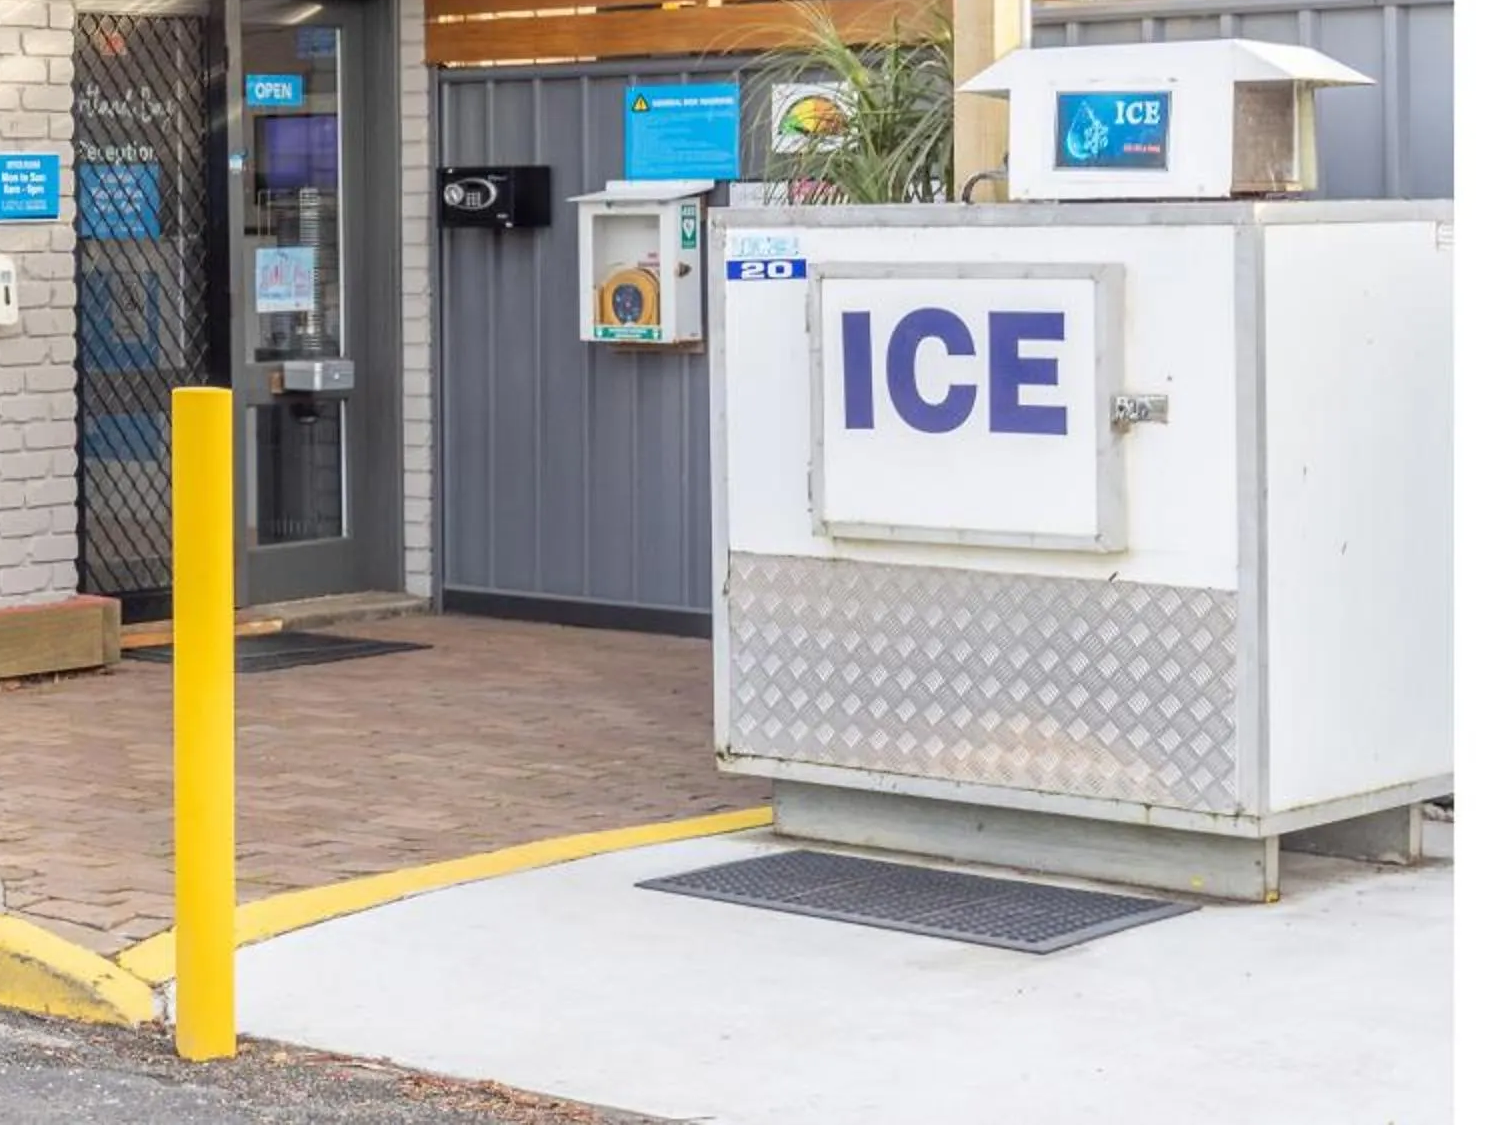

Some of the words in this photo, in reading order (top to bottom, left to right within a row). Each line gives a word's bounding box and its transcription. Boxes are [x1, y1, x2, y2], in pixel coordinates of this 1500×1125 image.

[255, 82, 293, 100] OPEN
[1114, 100, 1161, 124] ICE
[741, 262, 793, 279] 20
[841, 307, 1068, 435] ICE
